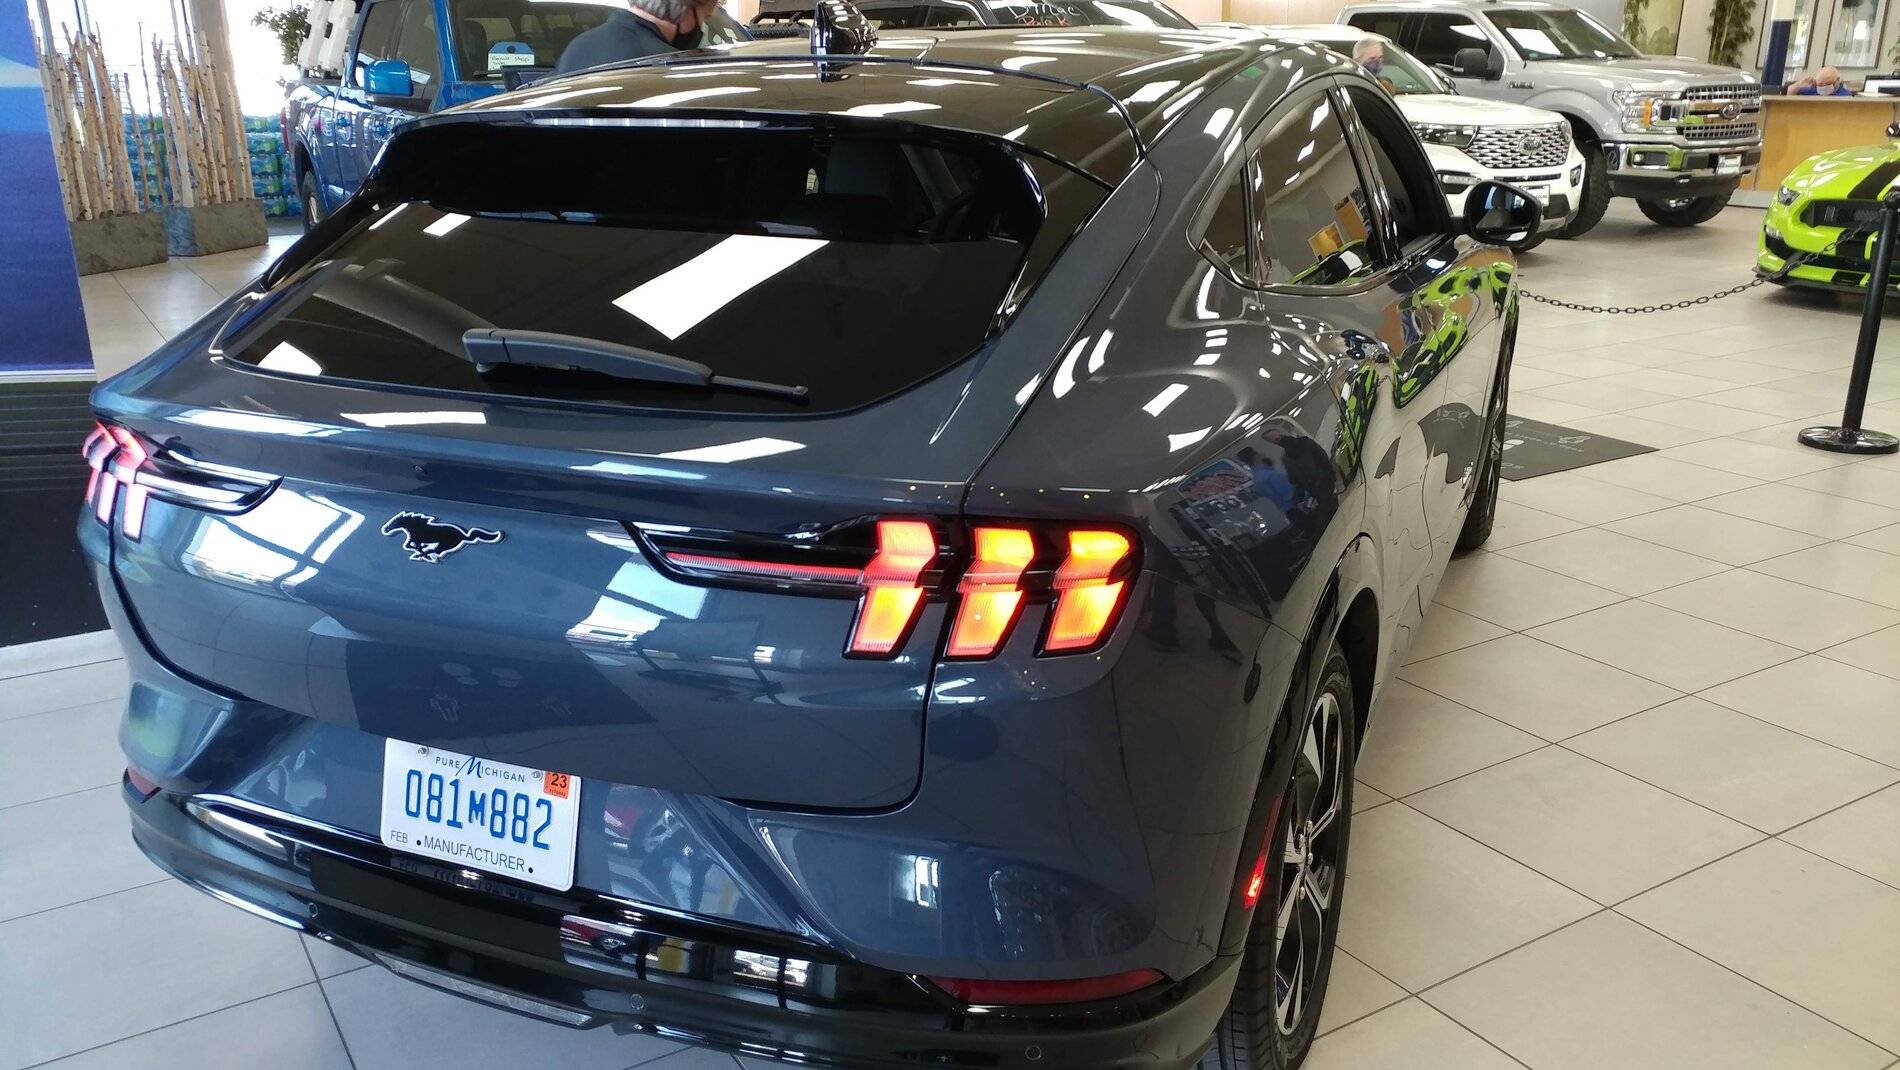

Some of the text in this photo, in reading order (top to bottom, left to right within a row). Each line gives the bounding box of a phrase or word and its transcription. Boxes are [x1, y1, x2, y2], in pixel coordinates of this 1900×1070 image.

[435, 756, 525, 783] PURE MICHIGAN
[551, 773, 568, 788] 23
[405, 769, 553, 850] 081M882
[390, 829, 525, 872] FEB MANUFACTURER
